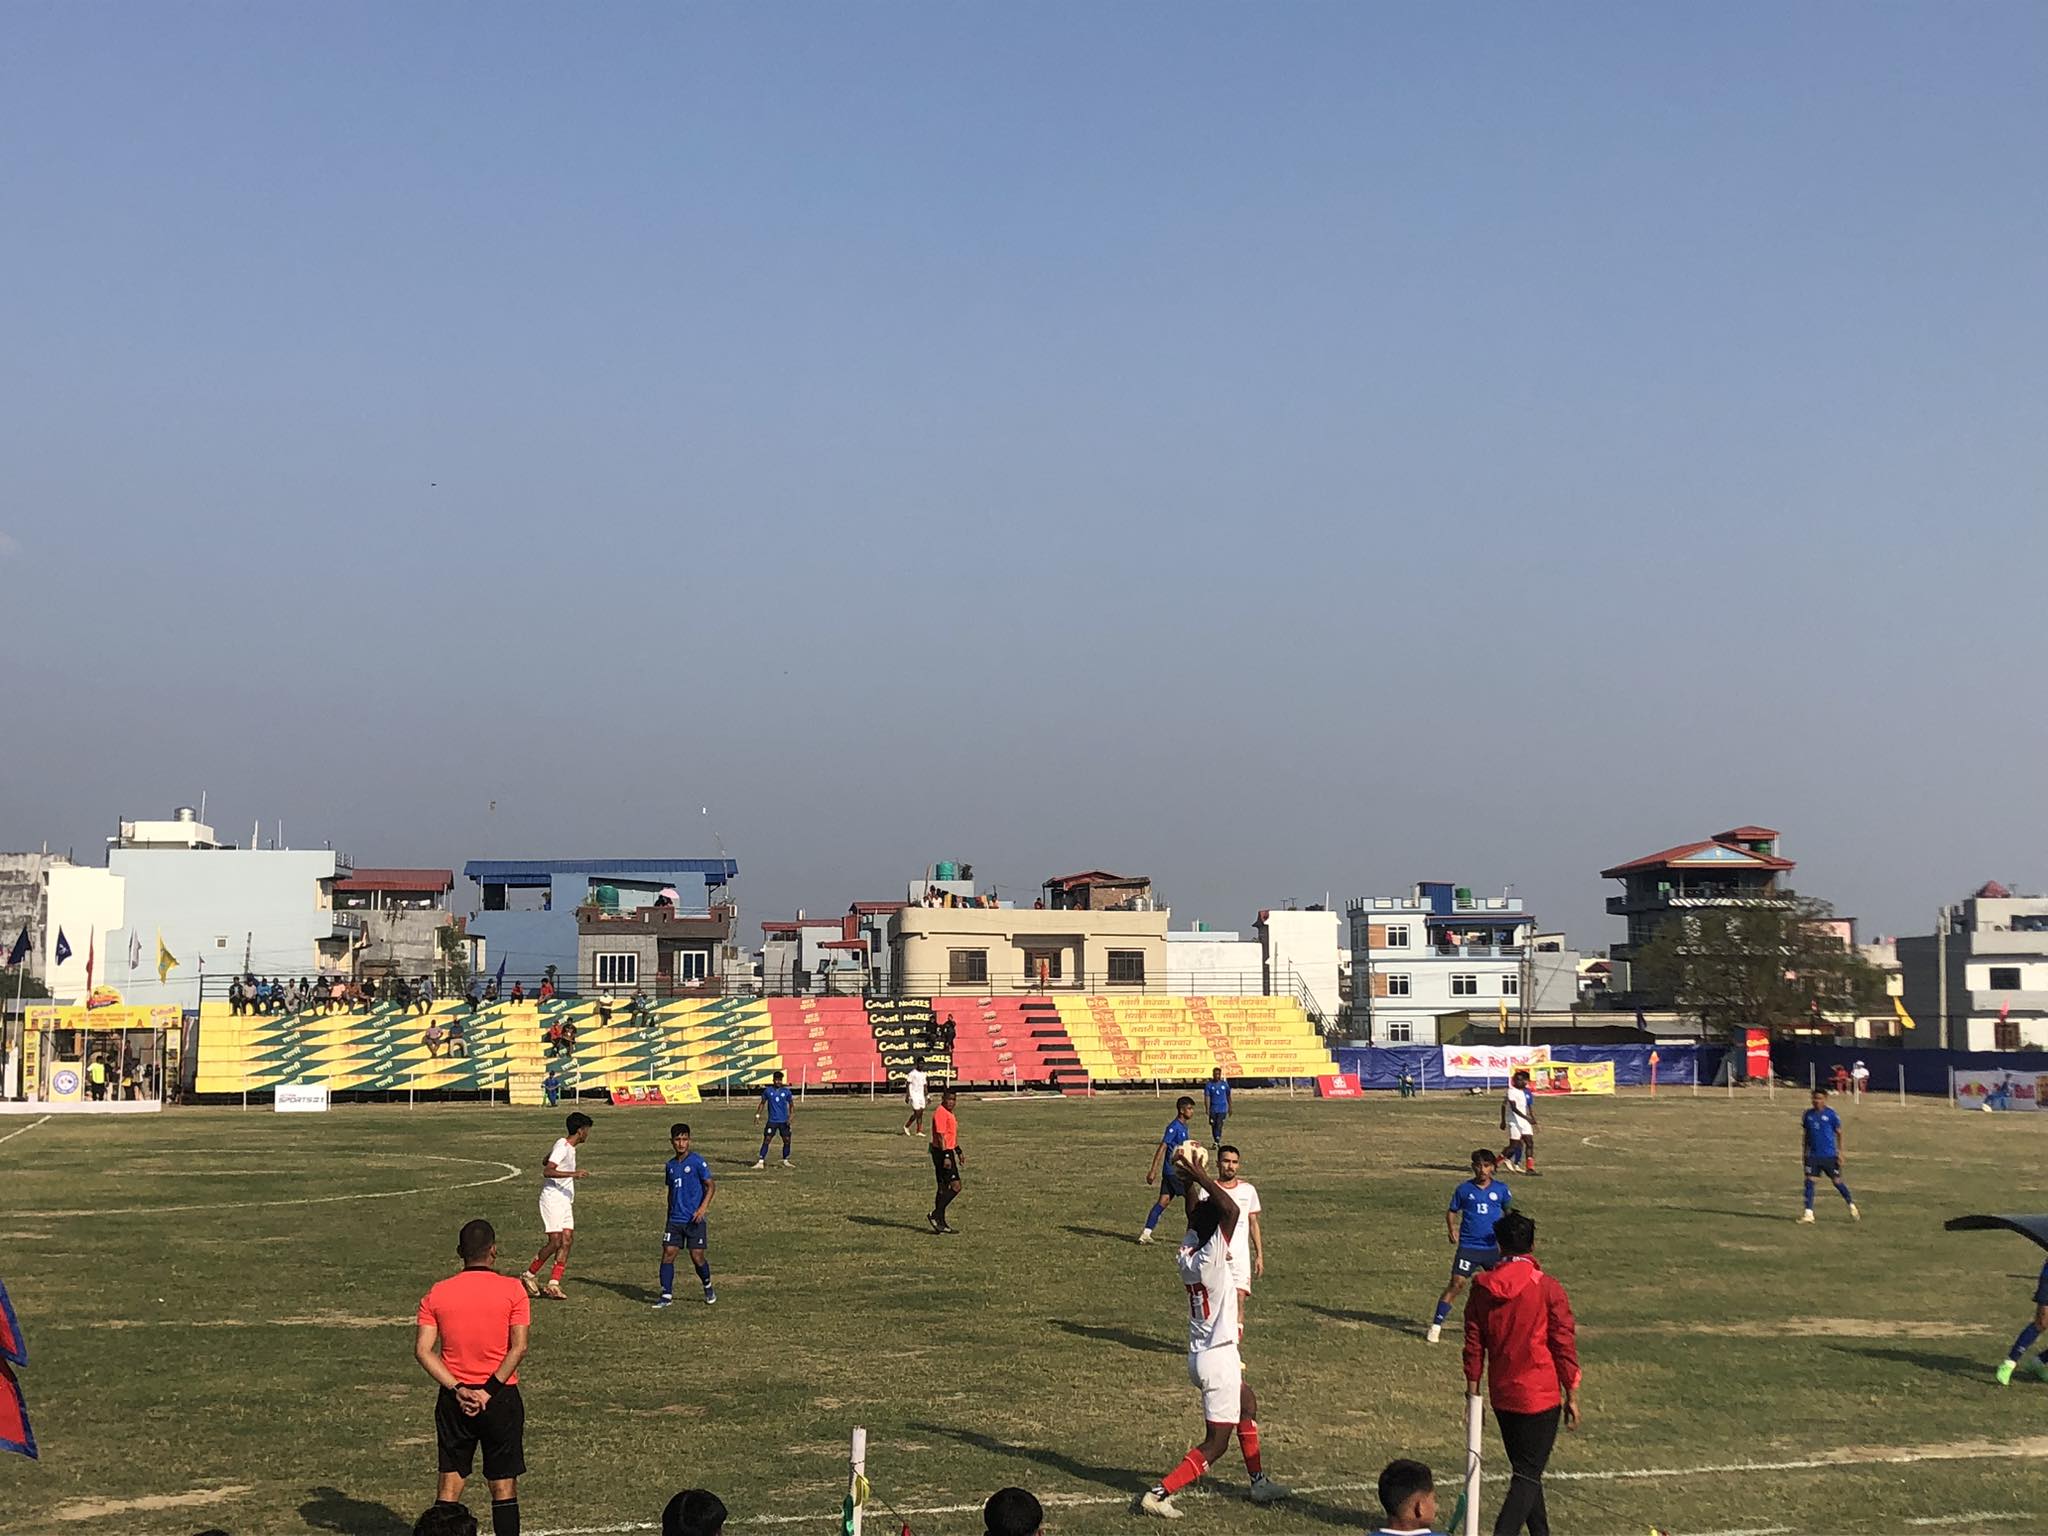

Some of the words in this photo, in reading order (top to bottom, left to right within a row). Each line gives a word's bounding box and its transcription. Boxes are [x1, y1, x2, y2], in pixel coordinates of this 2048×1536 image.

[1488, 1055, 1507, 1069] Red
[1477, 1203, 1488, 1214] 13
[1459, 1258, 1472, 1271] 13
